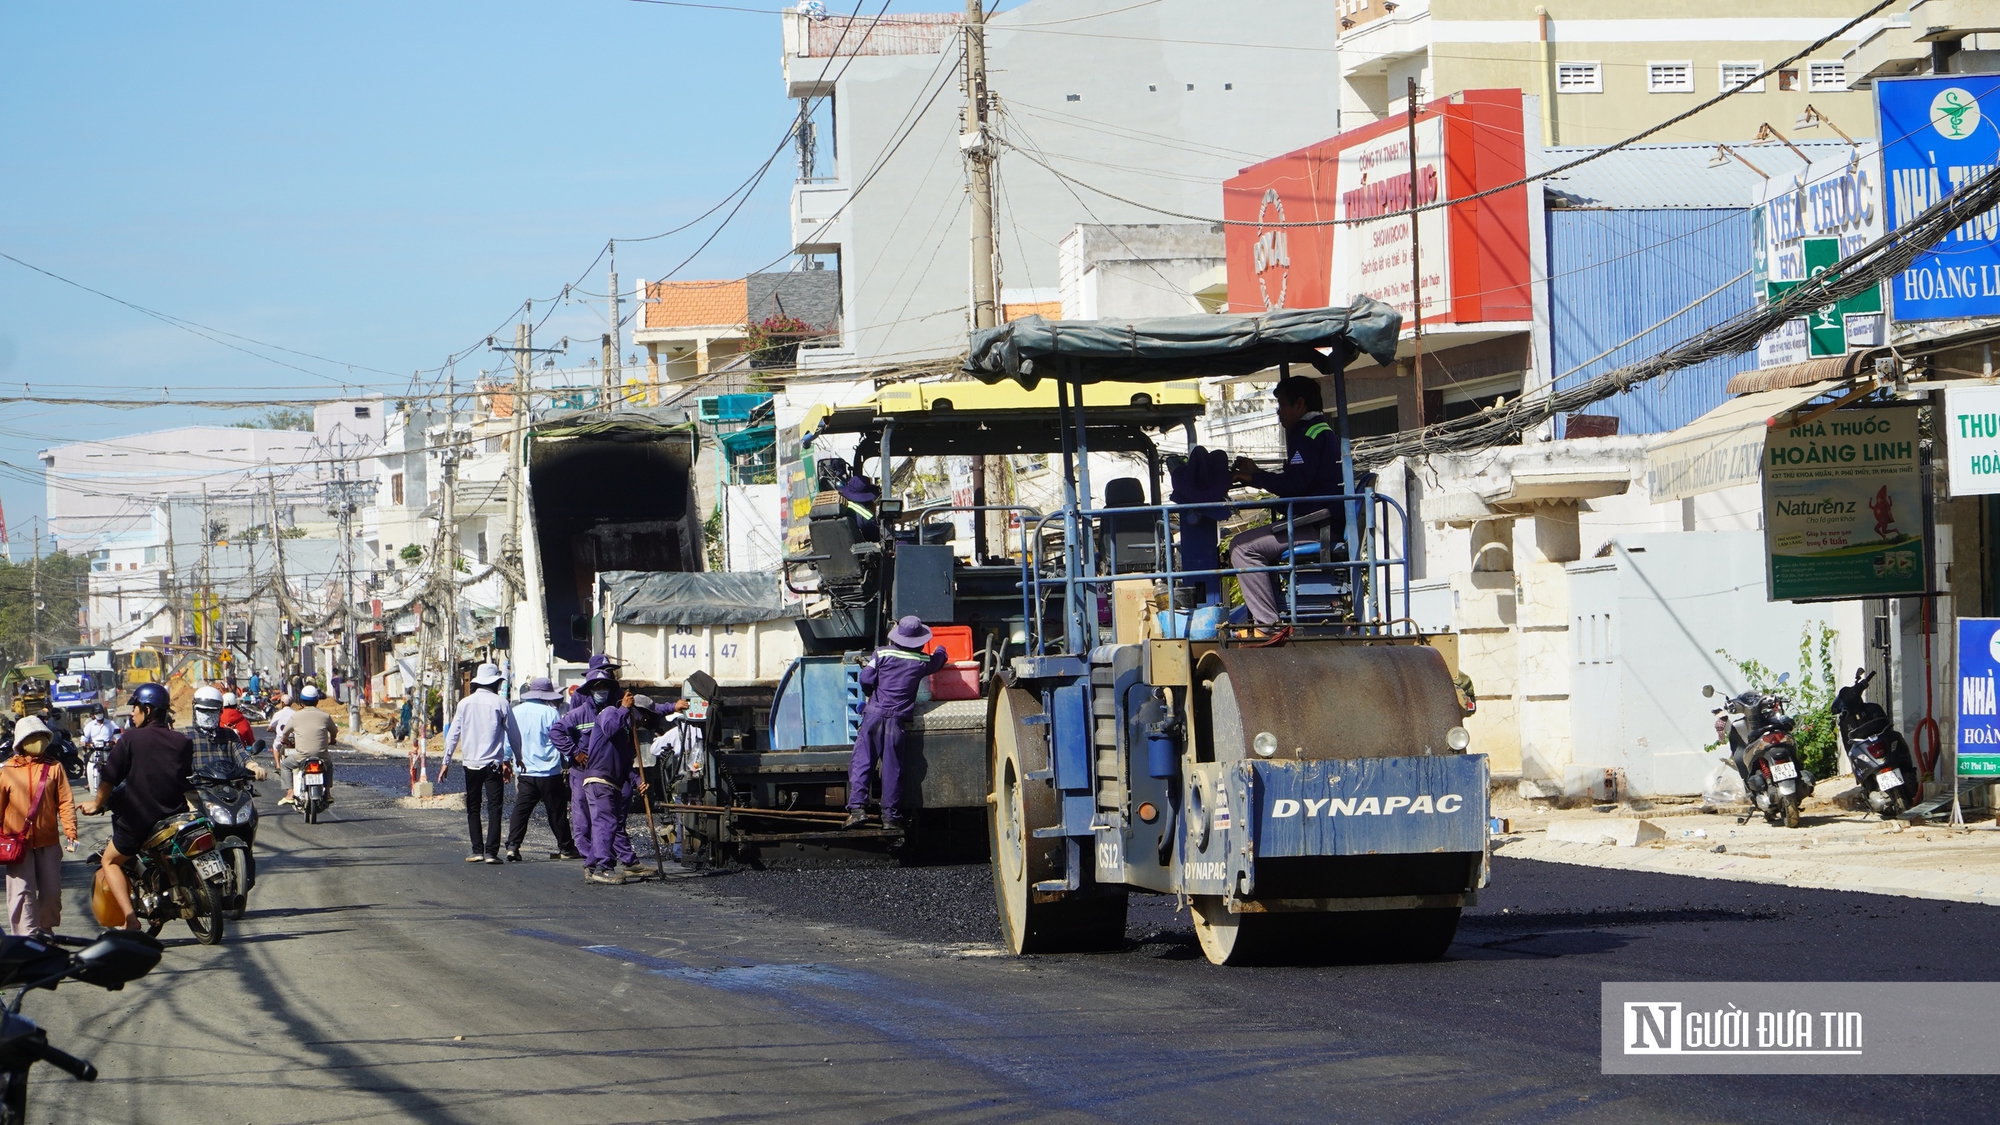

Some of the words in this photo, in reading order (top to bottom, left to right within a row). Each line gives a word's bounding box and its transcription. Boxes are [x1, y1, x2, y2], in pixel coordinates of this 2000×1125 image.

[1375, 149, 1383, 166] TY
[1383, 143, 1398, 162] TNHH
[1769, 174, 1806, 245] NHÀ
[1809, 148, 1873, 232] THUỐC
[1892, 151, 1946, 244] NHÀ
[1372, 222, 1409, 248] SHOWROOM
[1904, 257, 1977, 301] HOÀNG
[1790, 420, 1827, 438] NHÀ
[1831, 414, 1891, 437] THUỐC
[1957, 413, 2000, 439] THU
[1770, 441, 1856, 465] HOÀNG
[1863, 441, 1912, 462] LINH
[1776, 499, 1857, 516] Naturenz
[1806, 516, 1819, 524] Cho
[1822, 537, 1828, 546] 6
[671, 644, 697, 658] 144
[721, 644, 738, 658] 47
[1962, 669, 1997, 715] NHÀ
[1271, 794, 1463, 818] DYNAPAC
[1098, 842, 1118, 869] CS12
[1184, 861, 1226, 880] DYNAPAC
